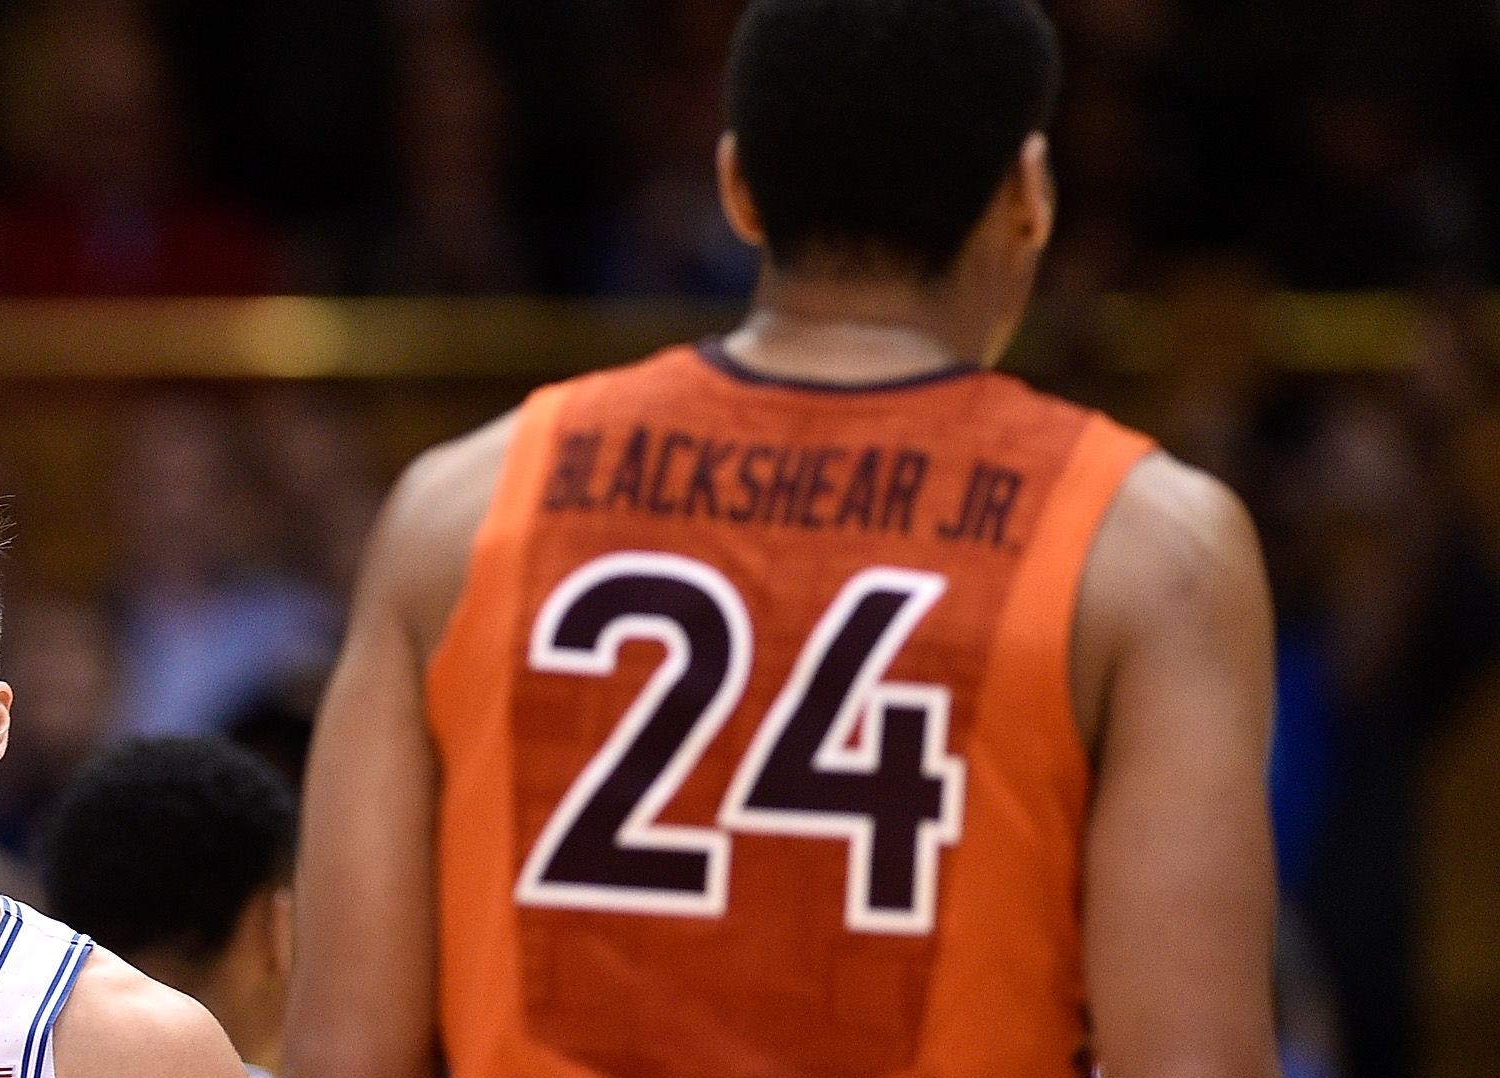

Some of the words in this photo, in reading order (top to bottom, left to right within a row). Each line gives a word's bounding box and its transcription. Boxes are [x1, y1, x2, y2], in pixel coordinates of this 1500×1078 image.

[544, 424, 928, 535] BLACKSHEAR
[937, 460, 1022, 558] JR.
[514, 550, 968, 936] 24
